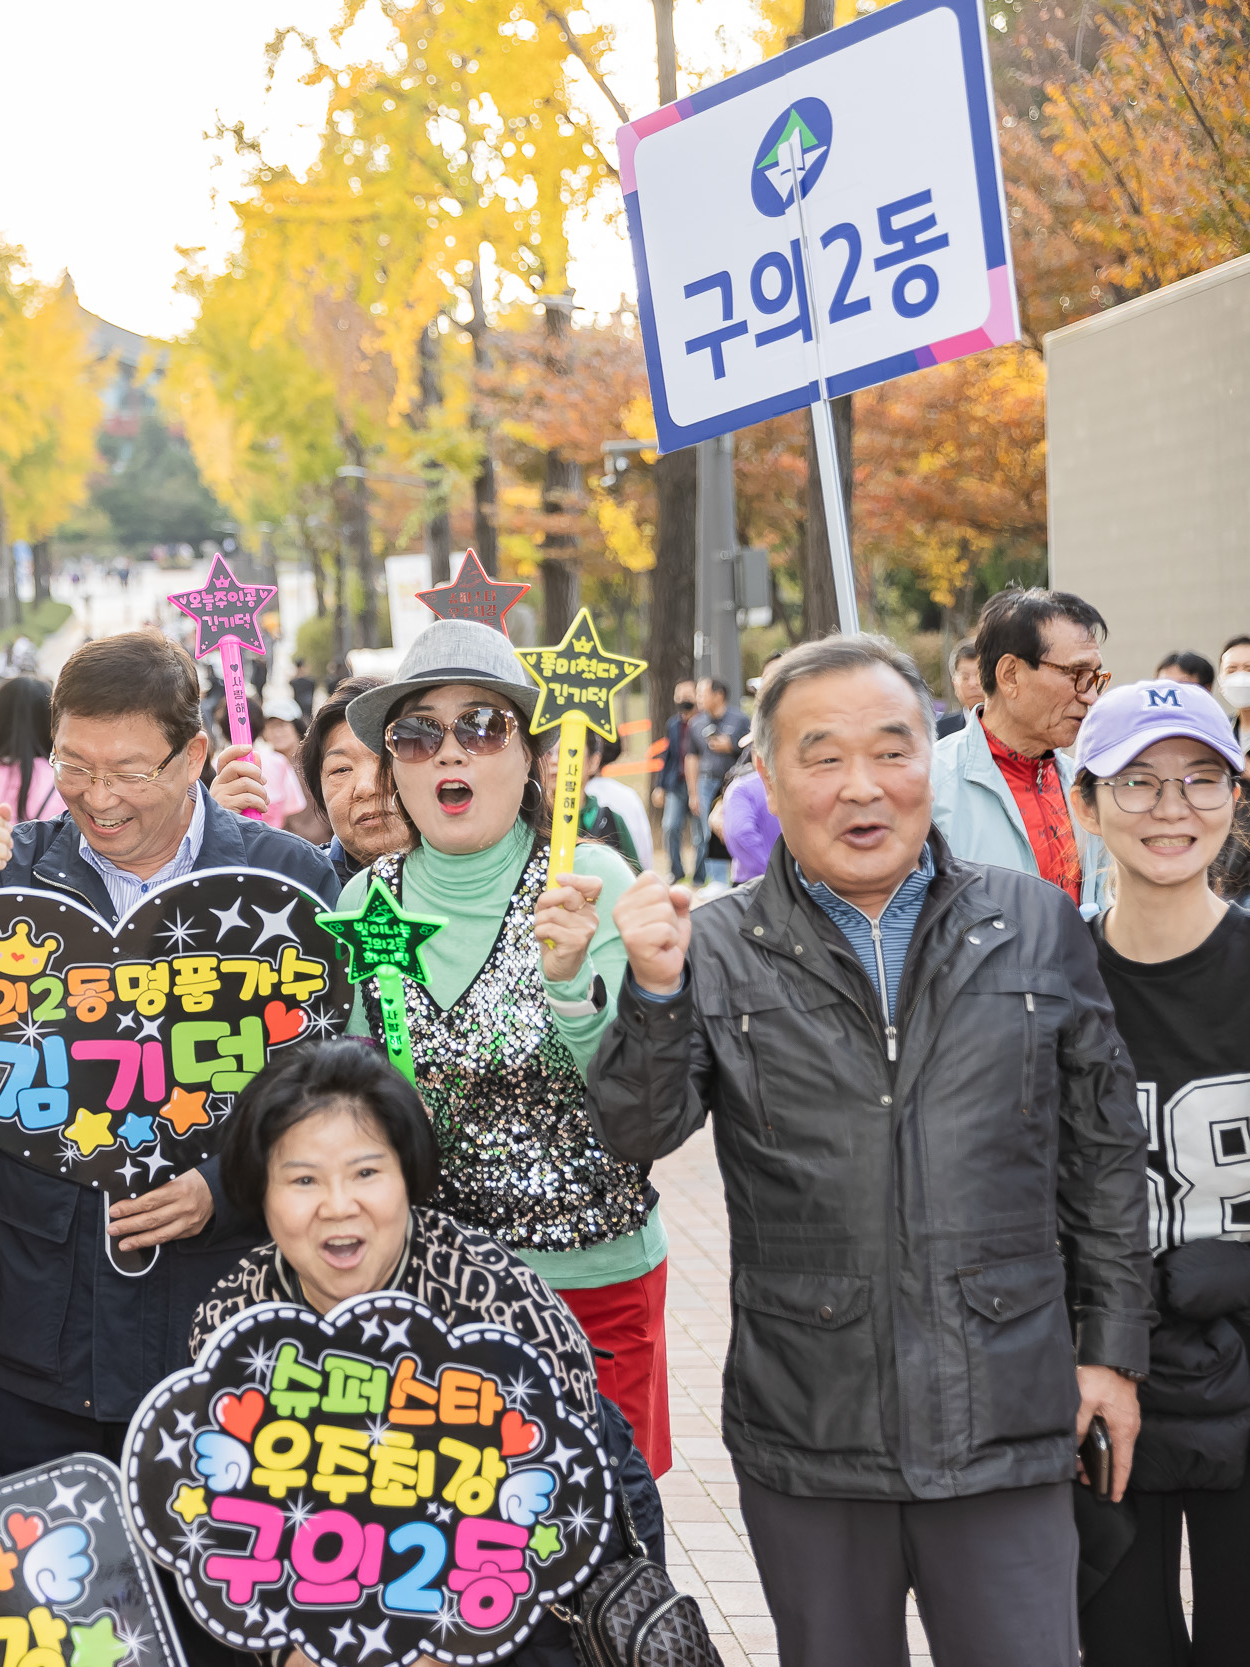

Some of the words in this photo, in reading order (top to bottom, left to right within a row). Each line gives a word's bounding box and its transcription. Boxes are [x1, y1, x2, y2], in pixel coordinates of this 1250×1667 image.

[683, 188, 950, 381] 구의2동
[189, 588, 257, 611] 오늘주인공
[202, 613, 251, 632] 김기덕
[540, 652, 619, 680] 폼미쳤다
[231, 676, 246, 714] 사랑해
[548, 682, 608, 709] 김기덕
[1145, 688, 1184, 708] M
[563, 764, 578, 810] 사랑해
[361, 937, 408, 953] 구의2동
[362, 951, 411, 967] 화이팅
[386, 1009, 403, 1046] 사랑해
[1137, 1072, 1250, 1258] 8
[269, 1344, 504, 1426] 슈퍼스타
[251, 1419, 507, 1516] 우주최강
[206, 1495, 530, 1629] 구의2동
